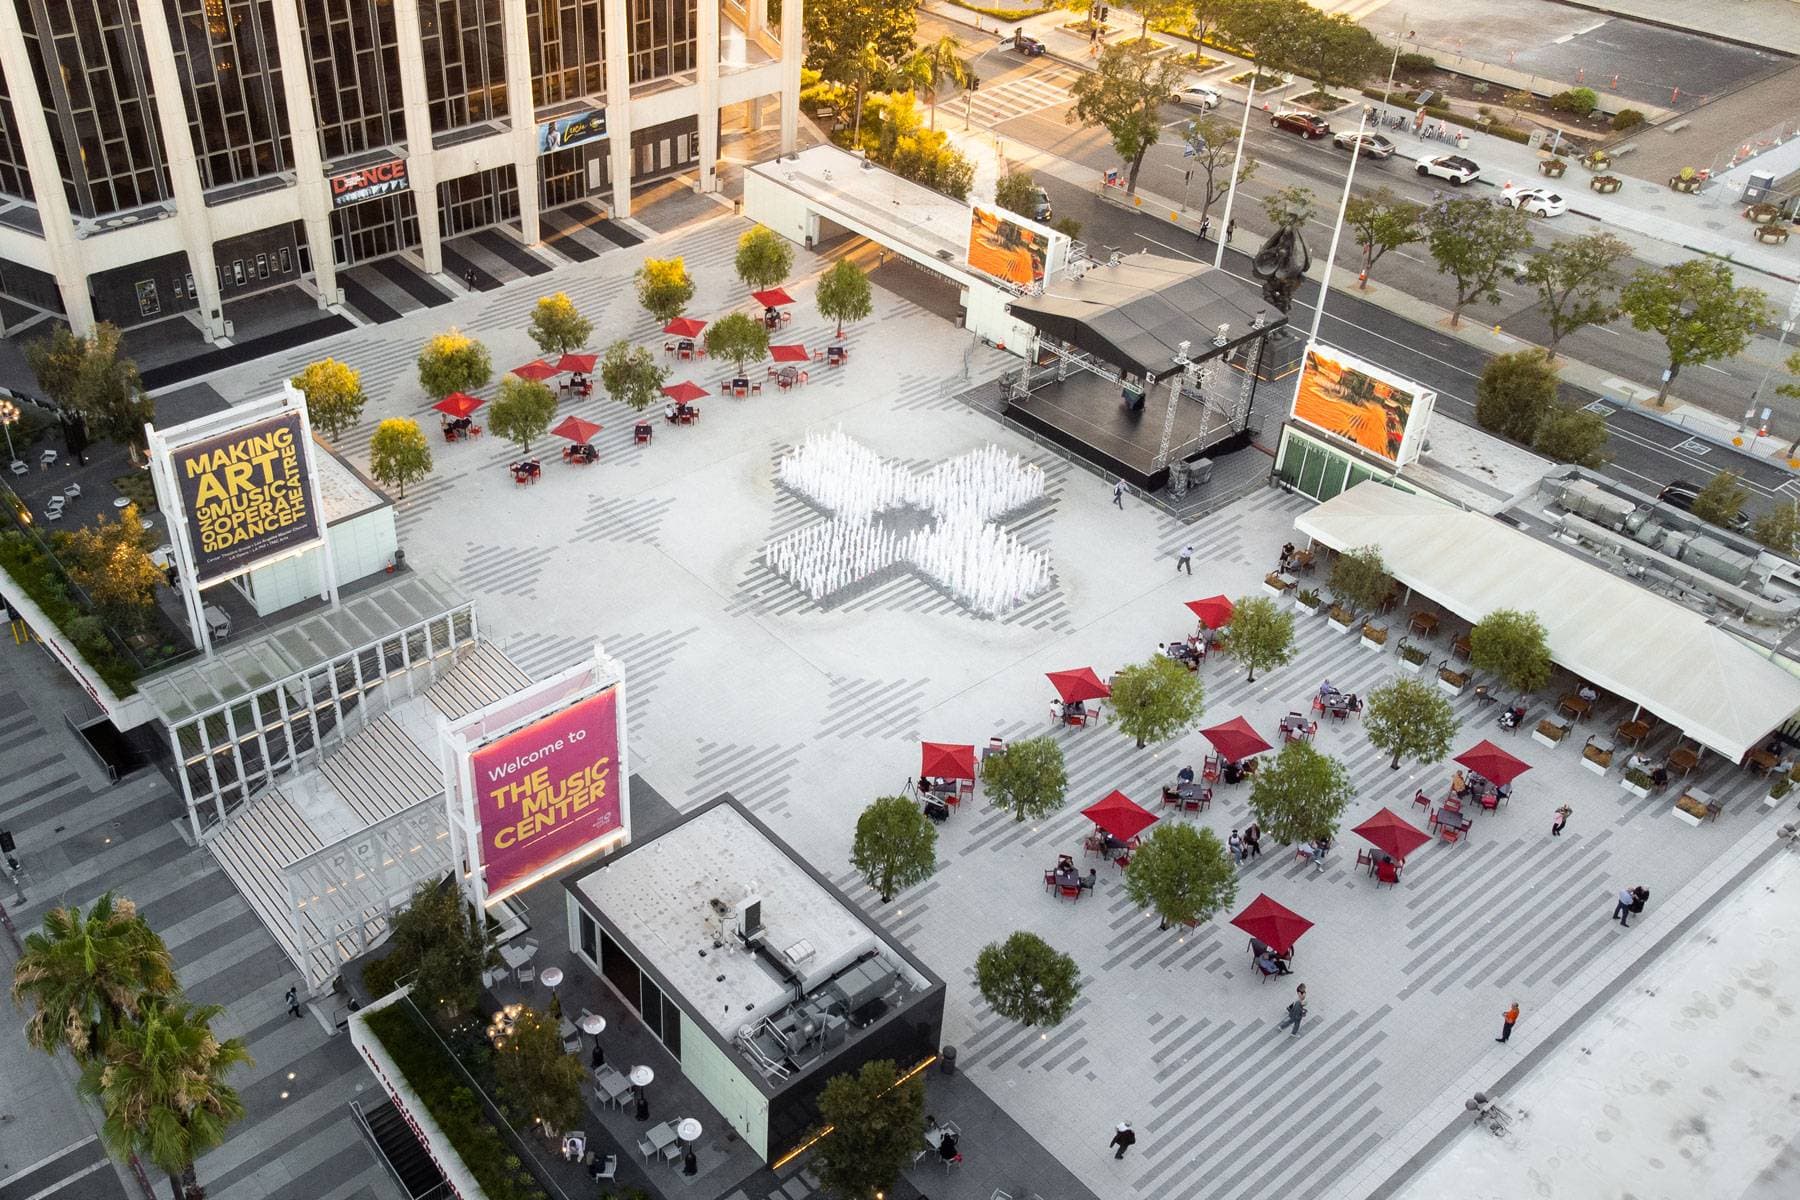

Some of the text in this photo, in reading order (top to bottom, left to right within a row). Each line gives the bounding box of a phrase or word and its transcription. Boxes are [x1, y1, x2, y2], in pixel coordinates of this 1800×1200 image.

[332, 160, 405, 194] DANCE
[915, 263, 942, 280] WELCOME
[185, 427, 293, 479] MAKING
[196, 450, 280, 508] ART
[210, 480, 288, 520] MUSIC
[282, 444, 306, 522] THEATRE
[196, 506, 218, 553] SONG
[214, 497, 290, 534] OPERA
[216, 511, 293, 550] DANCE
[488, 729, 587, 782] Welcome to
[489, 766, 551, 809] THE
[521, 756, 610, 819] MUSIC
[493, 779, 607, 849] CENTER
